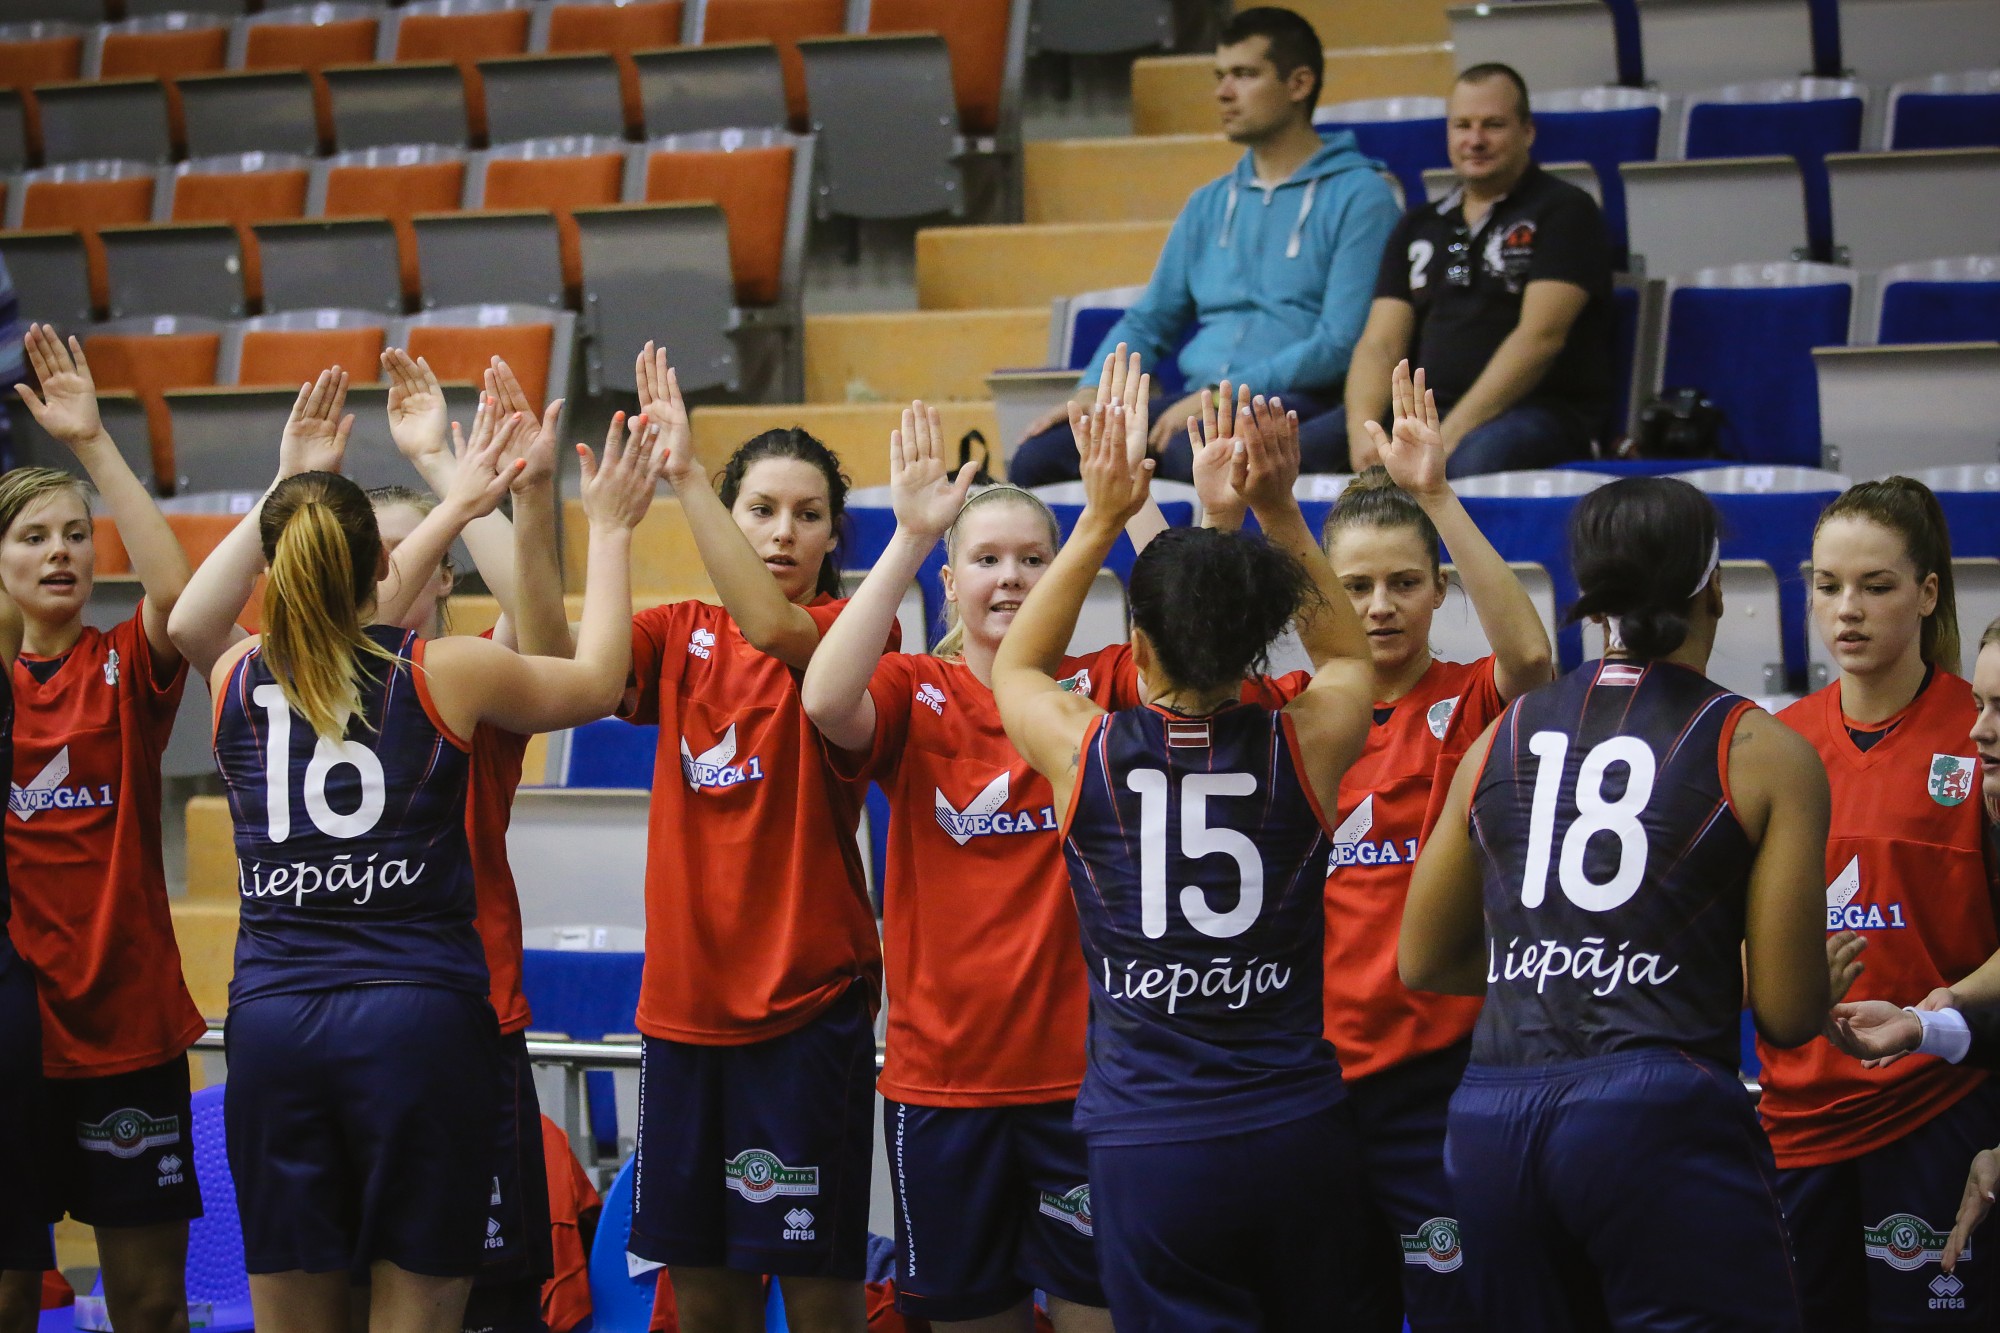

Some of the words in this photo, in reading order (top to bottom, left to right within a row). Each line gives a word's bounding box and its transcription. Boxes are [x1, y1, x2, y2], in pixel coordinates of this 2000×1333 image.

[1408, 239, 1434, 290] 2
[916, 691, 943, 716] errea
[253, 684, 386, 843] 16
[689, 762, 745, 787] VEGA
[748, 756, 764, 780] 1
[13, 786, 96, 811] VEGA
[99, 784, 114, 806] 1
[950, 810, 1037, 836] VEGA
[1040, 806, 1058, 831] 1
[1521, 731, 1656, 912] 18
[1126, 768, 1264, 939] 15
[1404, 838, 1418, 862] 1
[1889, 902, 1906, 928] 1
[1103, 956, 1292, 1014] Liepāja
[158, 1173, 184, 1187] errea
[896, 1103, 916, 1278] www.sportapunkts.lv
[783, 1229, 815, 1240] errea
[1928, 1298, 1965, 1309] errea
